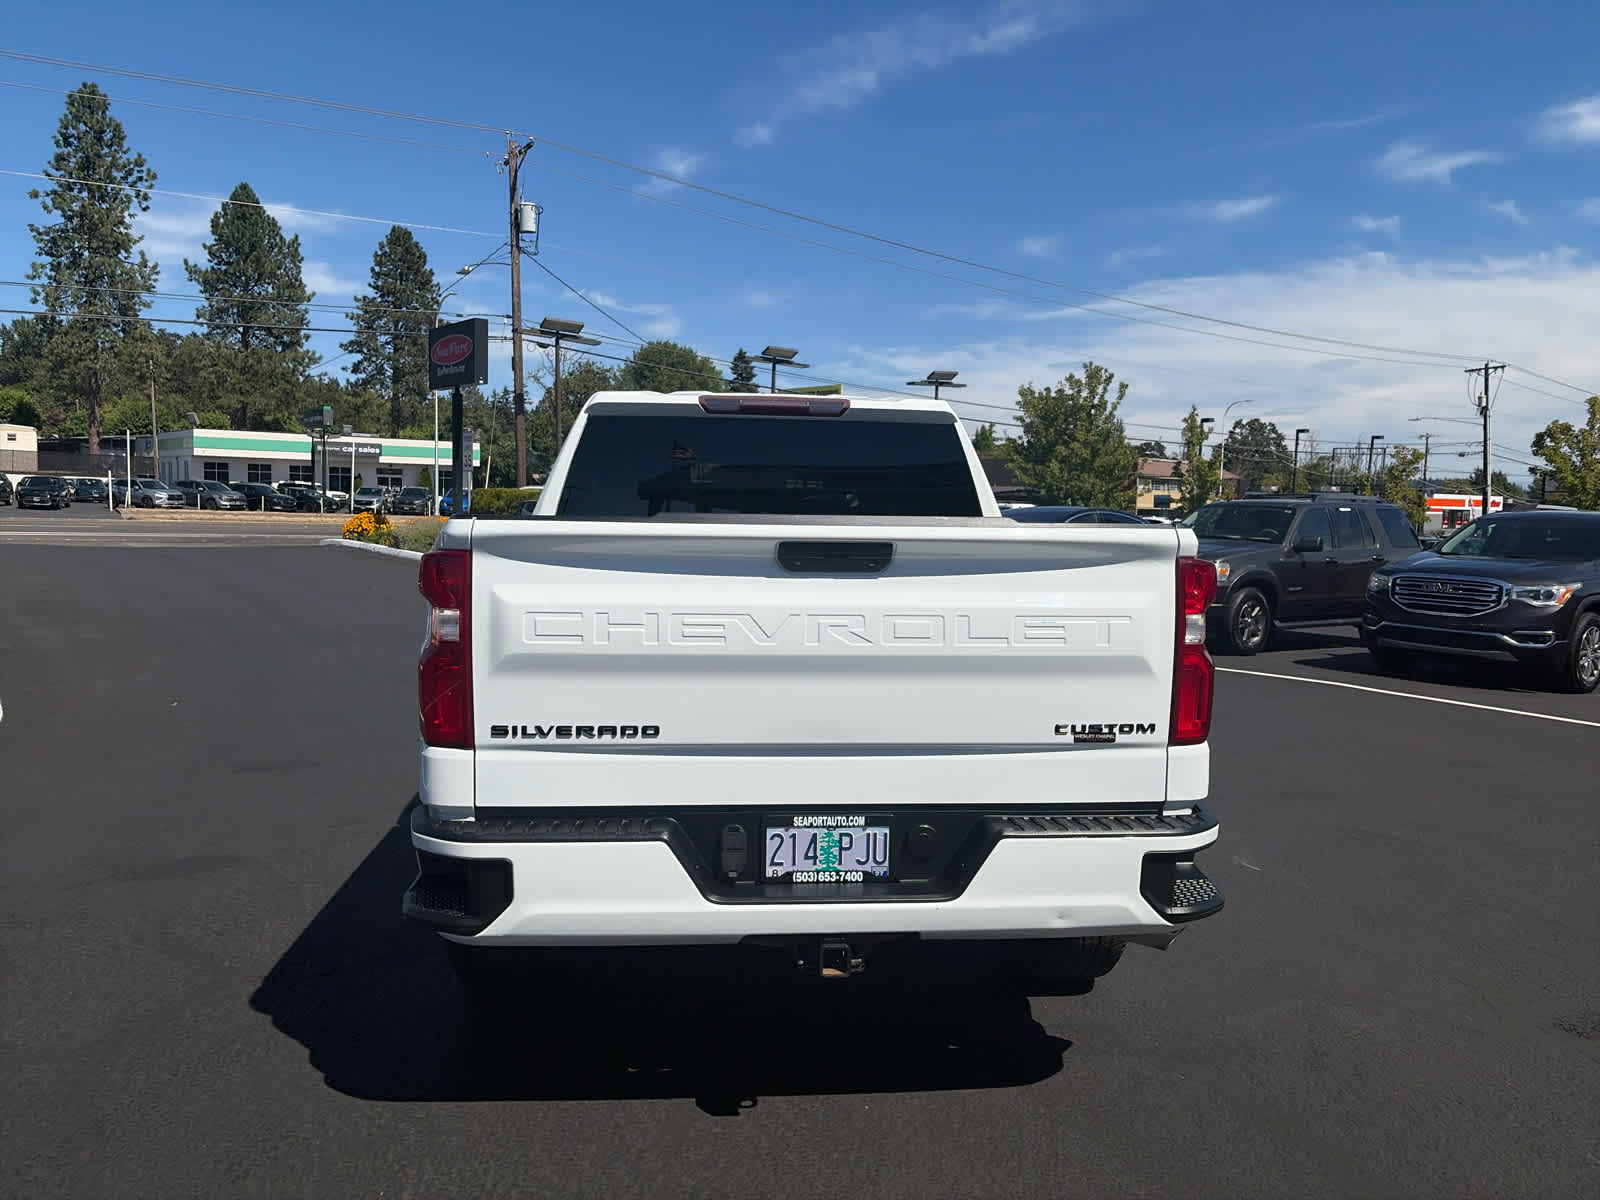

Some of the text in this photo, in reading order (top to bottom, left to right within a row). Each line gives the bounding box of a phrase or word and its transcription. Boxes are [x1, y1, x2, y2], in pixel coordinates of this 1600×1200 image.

[358, 445, 380, 454] sales
[521, 610, 1133, 648] CHEVROLET
[490, 724, 661, 740] SILVERADO
[1054, 723, 1156, 736] CUSTOM
[793, 816, 865, 827] SEAPORTAUTO.COM
[769, 832, 888, 867] 214 PJU
[792, 871, 817, 882] (503)
[818, 871, 864, 882] 653-7400
